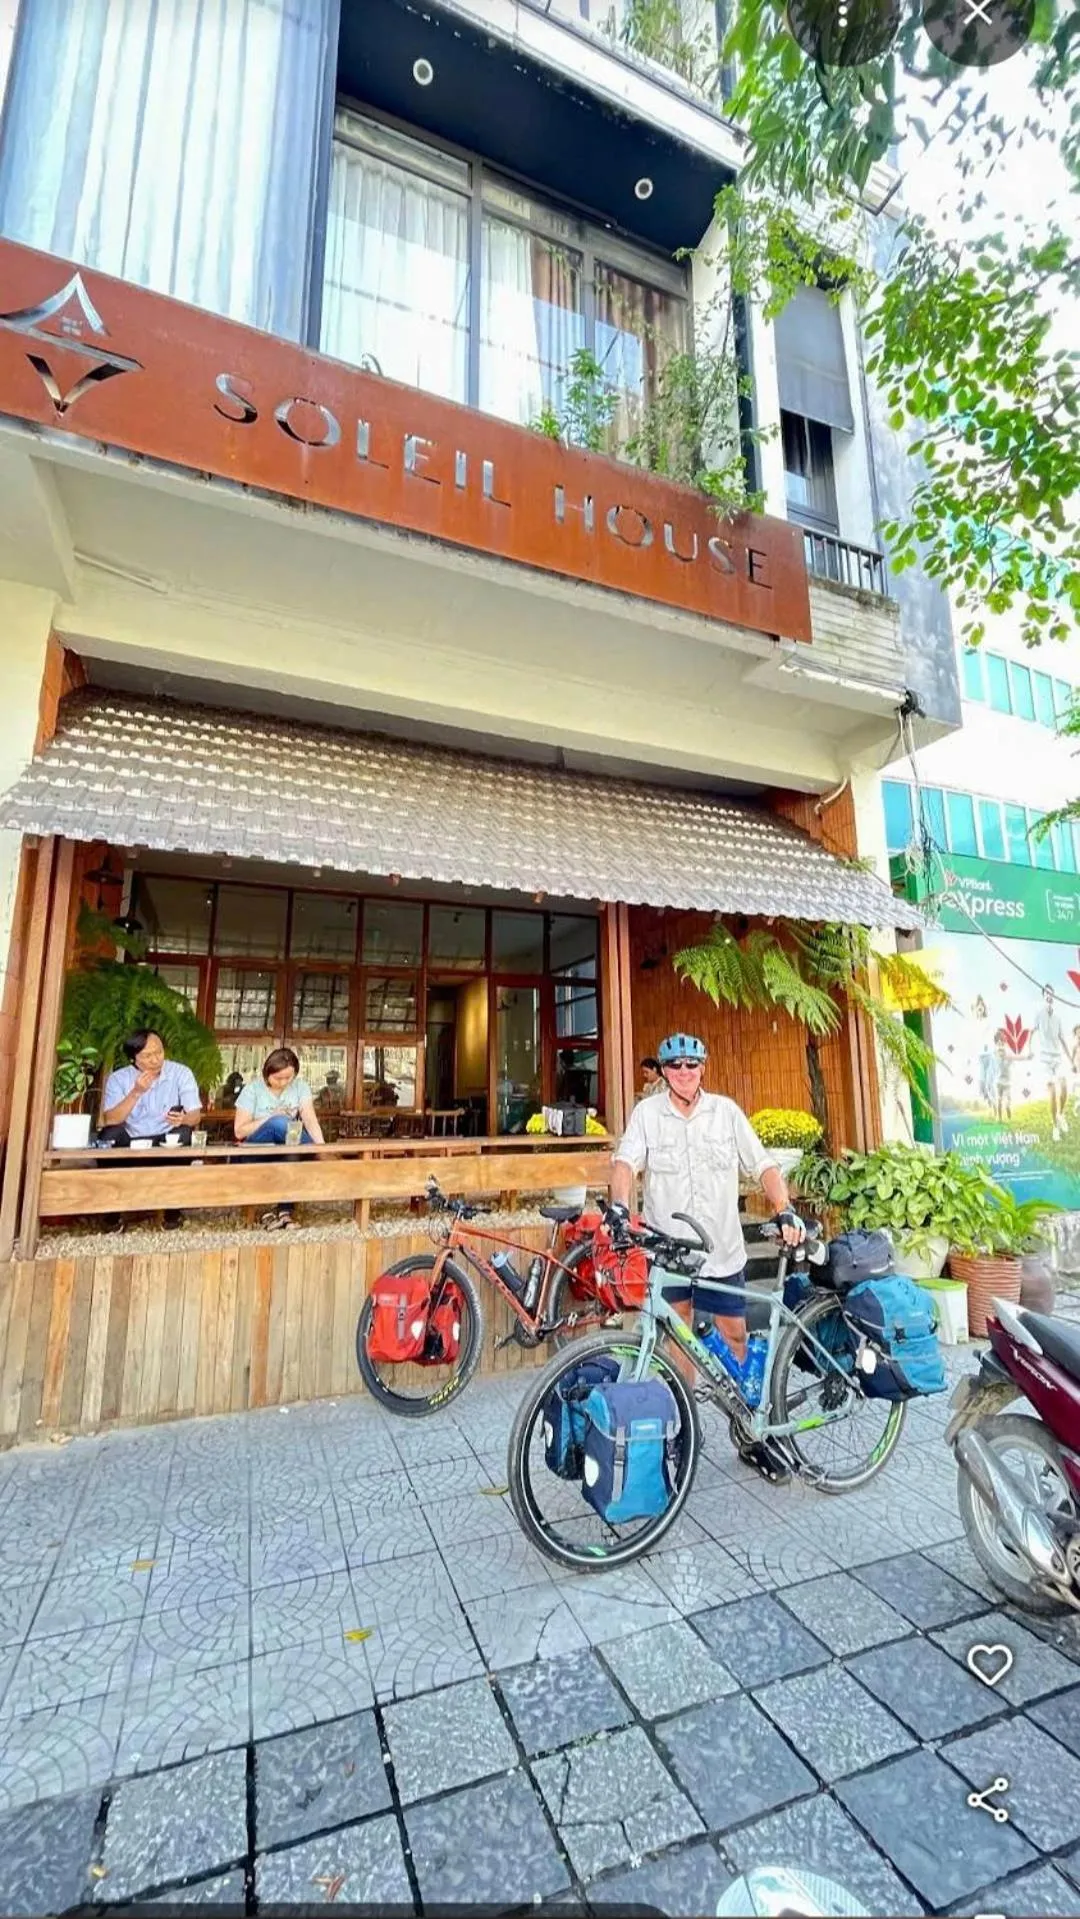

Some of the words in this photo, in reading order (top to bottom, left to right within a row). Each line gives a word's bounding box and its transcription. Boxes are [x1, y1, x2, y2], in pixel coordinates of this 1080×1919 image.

[213, 372, 512, 507] SOLEIL
[553, 484, 773, 590] HOUSE
[1014, 1129, 1040, 1145] Nam
